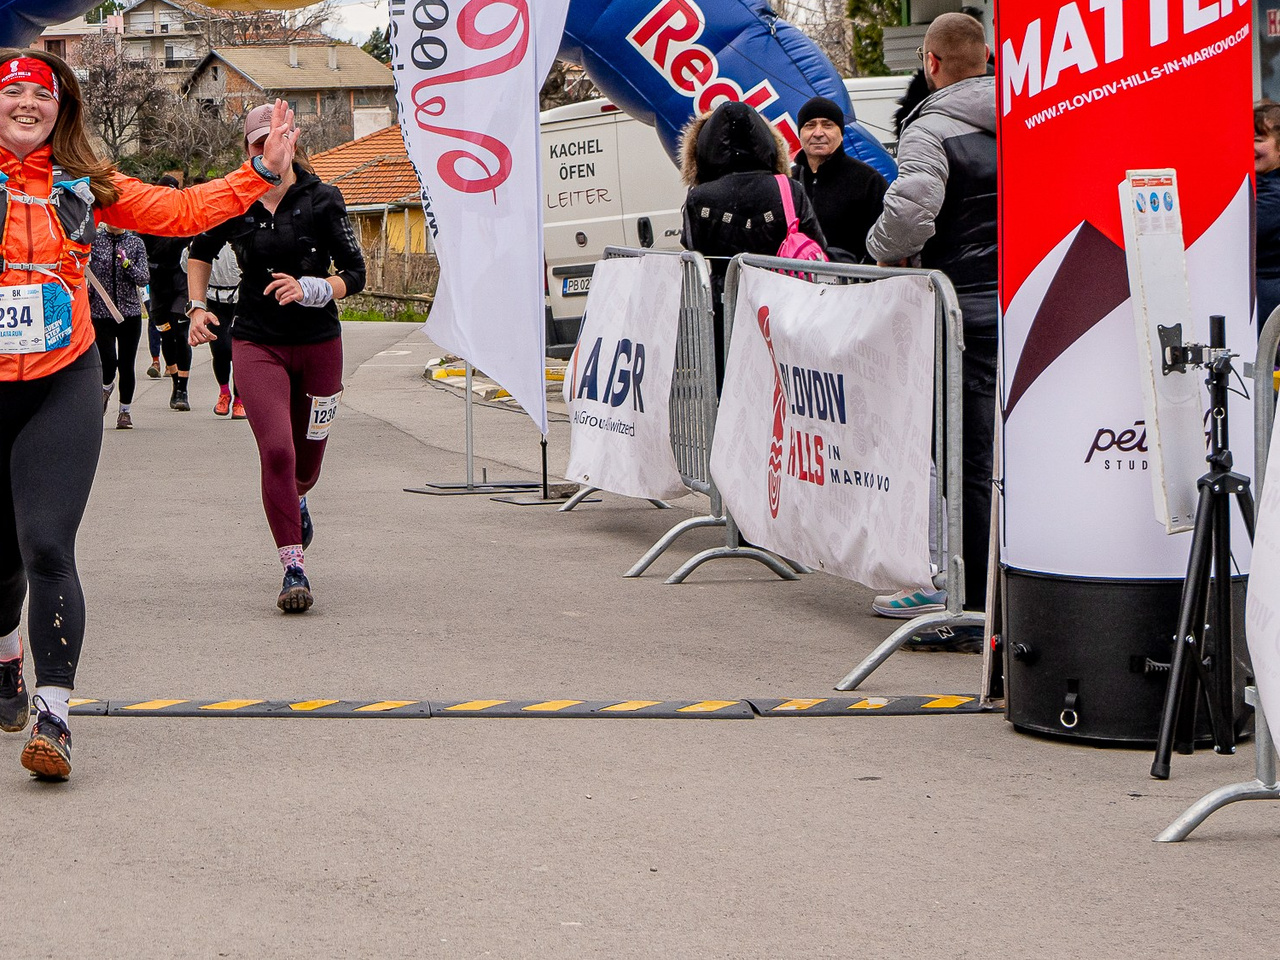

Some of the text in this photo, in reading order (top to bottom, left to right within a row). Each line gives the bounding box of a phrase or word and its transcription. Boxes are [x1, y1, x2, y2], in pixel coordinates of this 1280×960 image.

[1025, 24, 1250, 129] WWW.PLOVDIV-HILLS-IN-MARKOVO.COM
[550, 139, 603, 159] KACHEL
[559, 163, 595, 180] ÖFEN
[547, 188, 611, 208] LEITER
[828, 444, 841, 460] IN
[1104, 459, 1149, 470] STUD
[830, 469, 890, 492] MARKOVO
